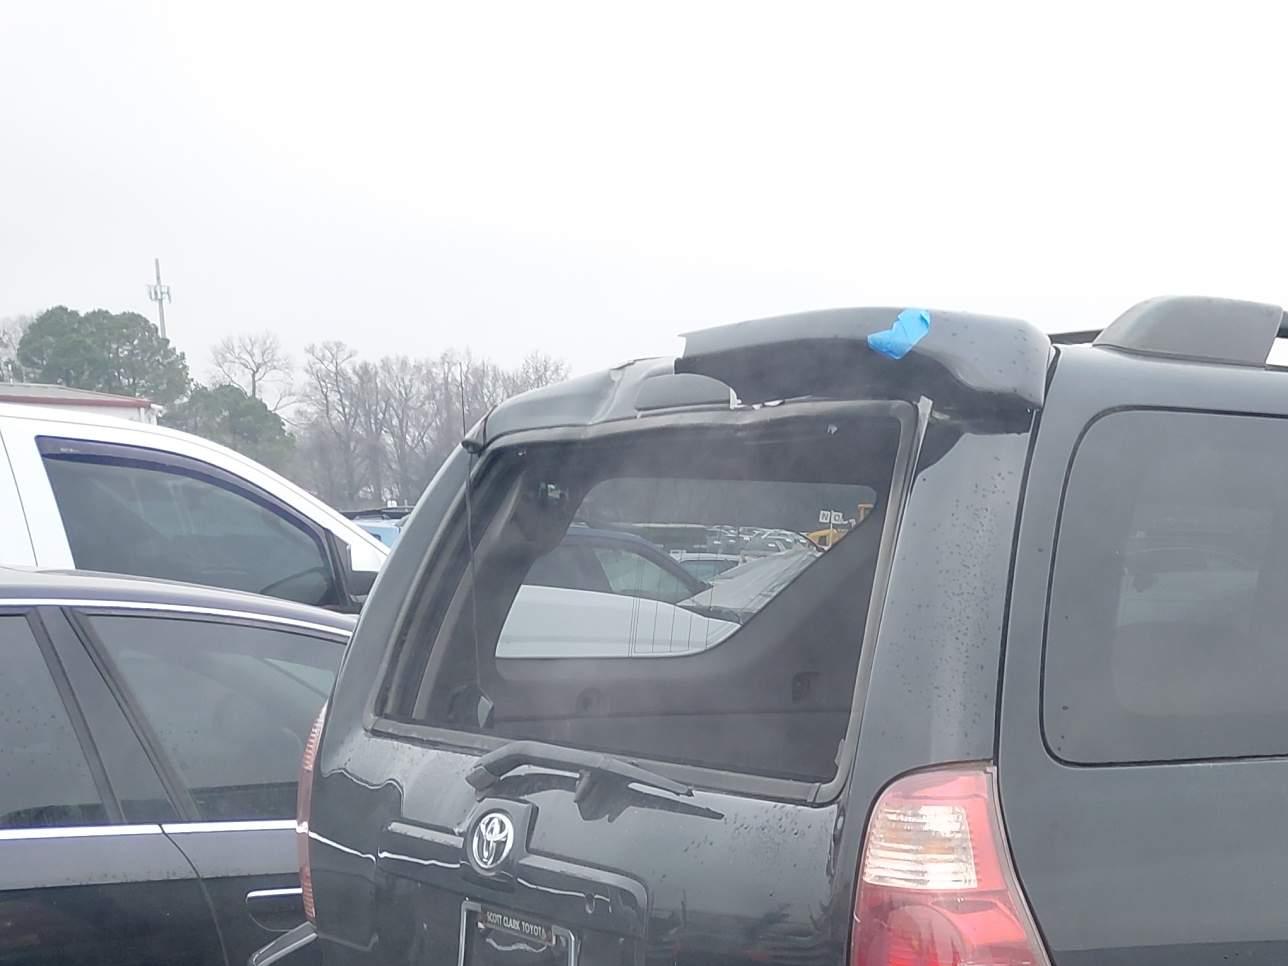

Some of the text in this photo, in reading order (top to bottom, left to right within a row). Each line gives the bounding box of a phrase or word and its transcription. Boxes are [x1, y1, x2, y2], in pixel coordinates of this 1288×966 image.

[486, 911, 546, 938] SCOTT CLARK TOYOTA
